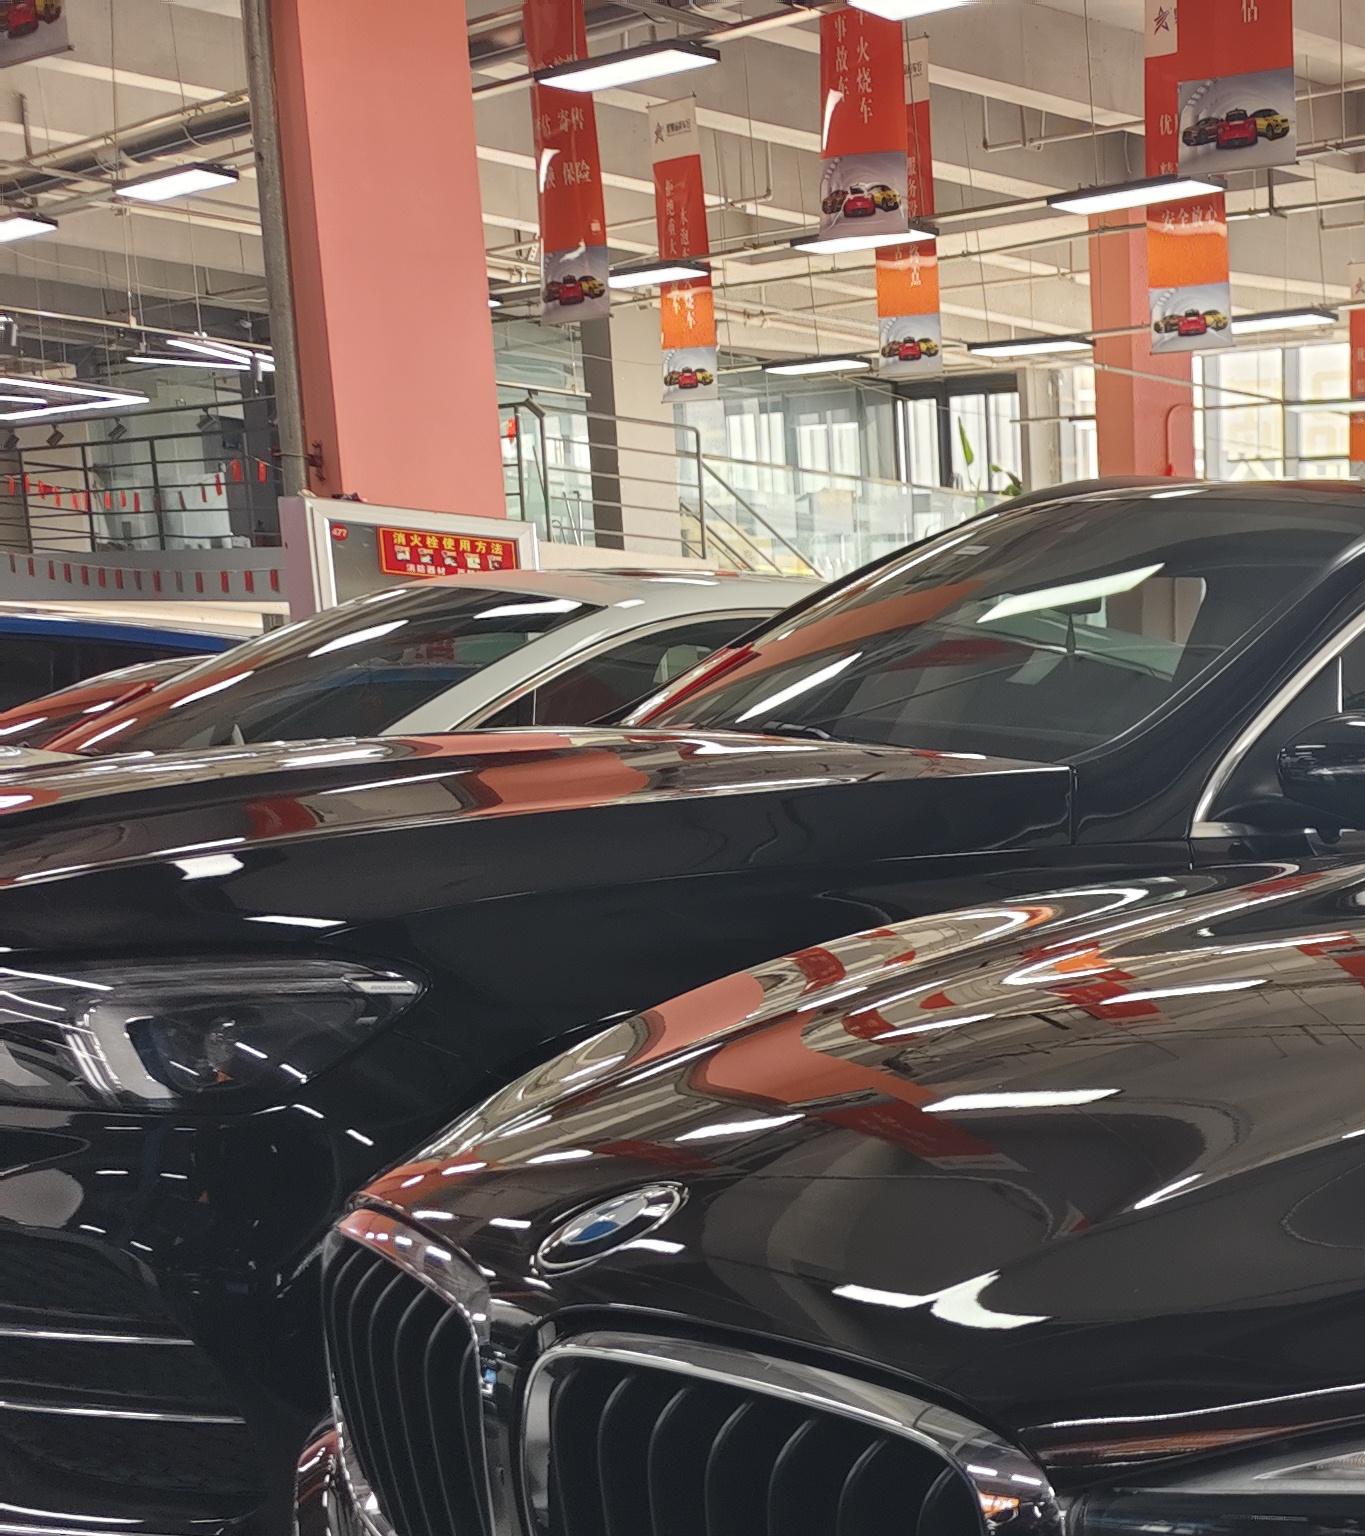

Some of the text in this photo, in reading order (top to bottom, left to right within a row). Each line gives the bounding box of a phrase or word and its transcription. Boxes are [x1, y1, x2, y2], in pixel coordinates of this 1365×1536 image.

[392, 532, 504, 555] 消火栓使用方法
